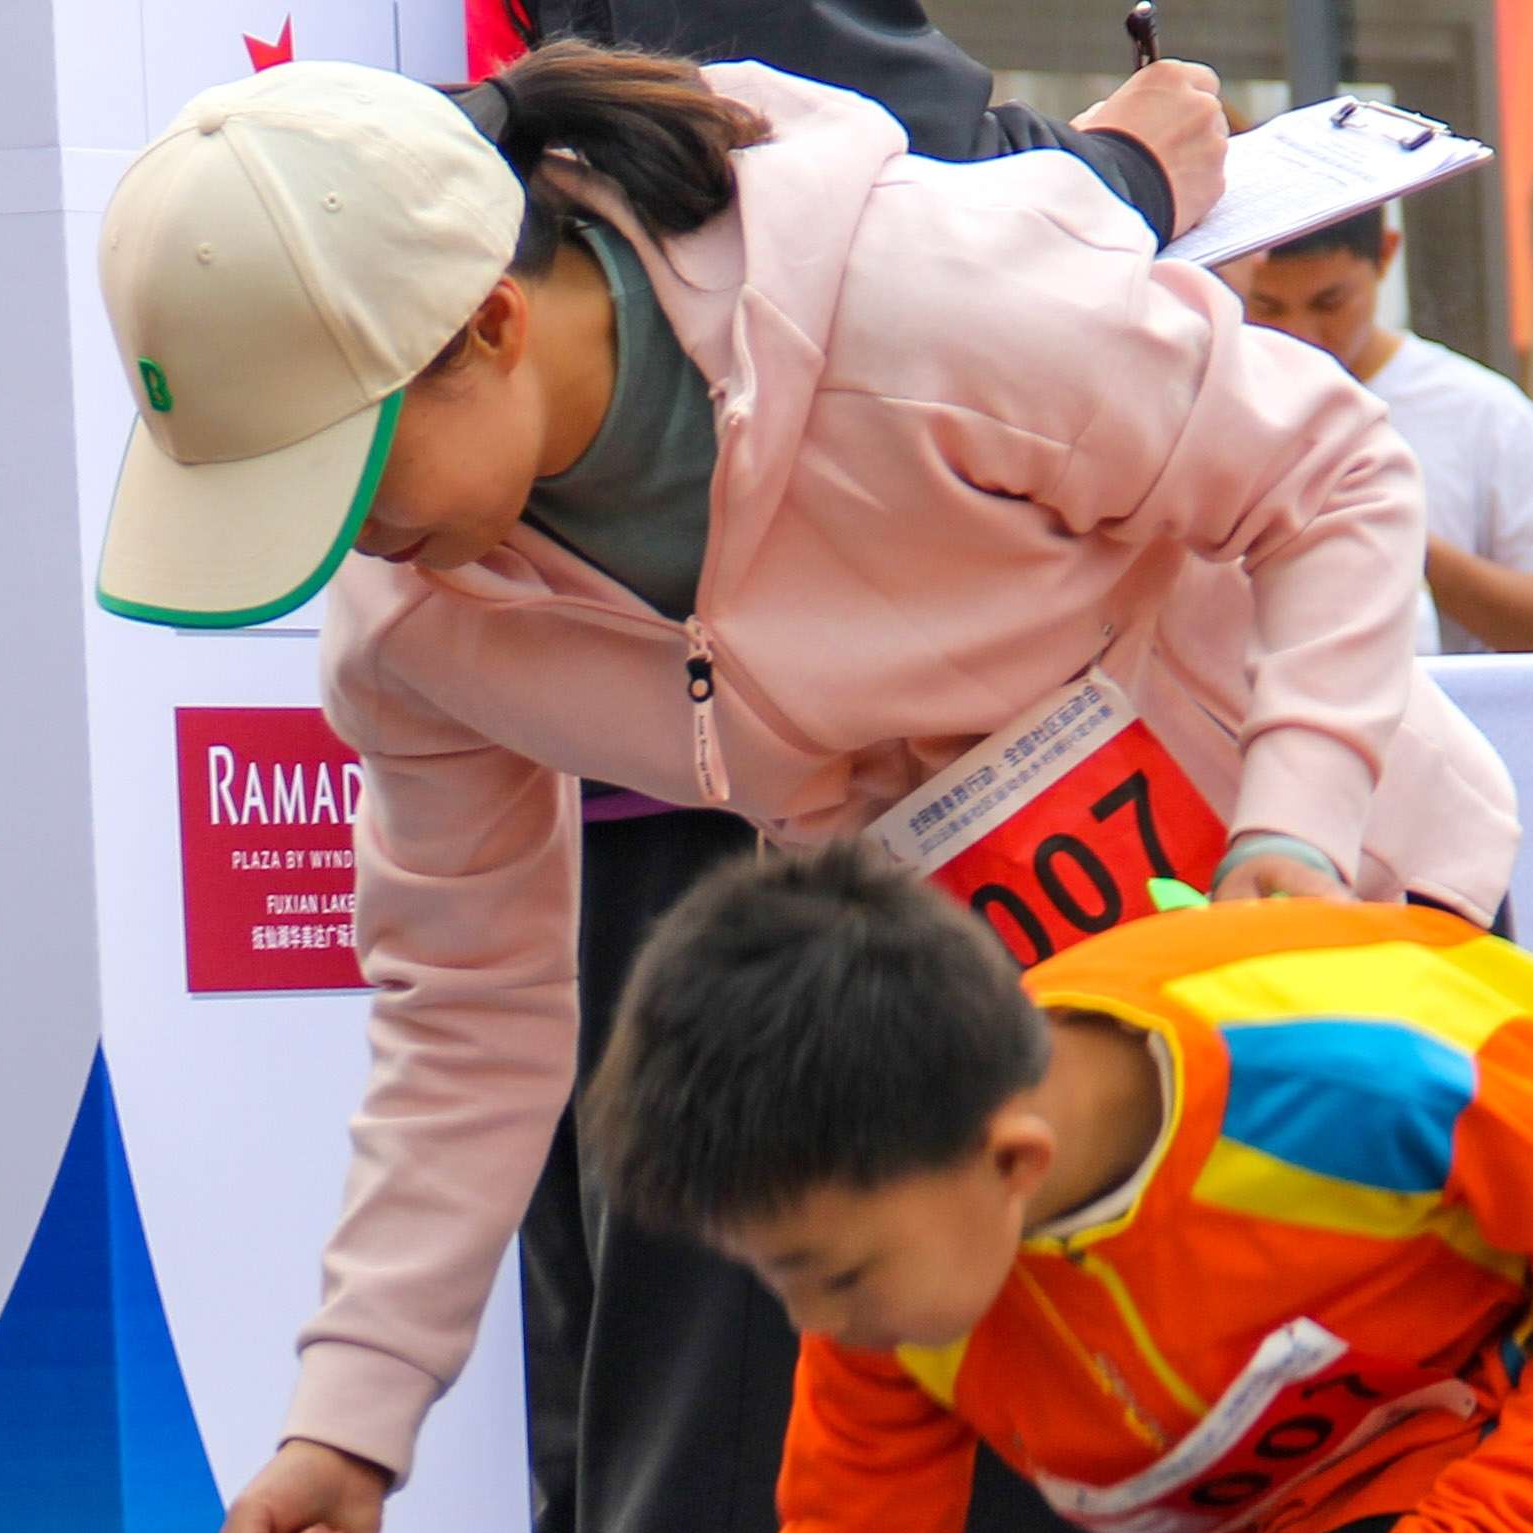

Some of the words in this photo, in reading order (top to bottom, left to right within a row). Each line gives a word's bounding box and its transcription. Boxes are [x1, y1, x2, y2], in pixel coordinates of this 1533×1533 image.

[138, 356, 175, 413] B
[232, 850, 281, 870] PLAZA
[286, 850, 305, 869] BY
[266, 894, 318, 915] FUXIAN
